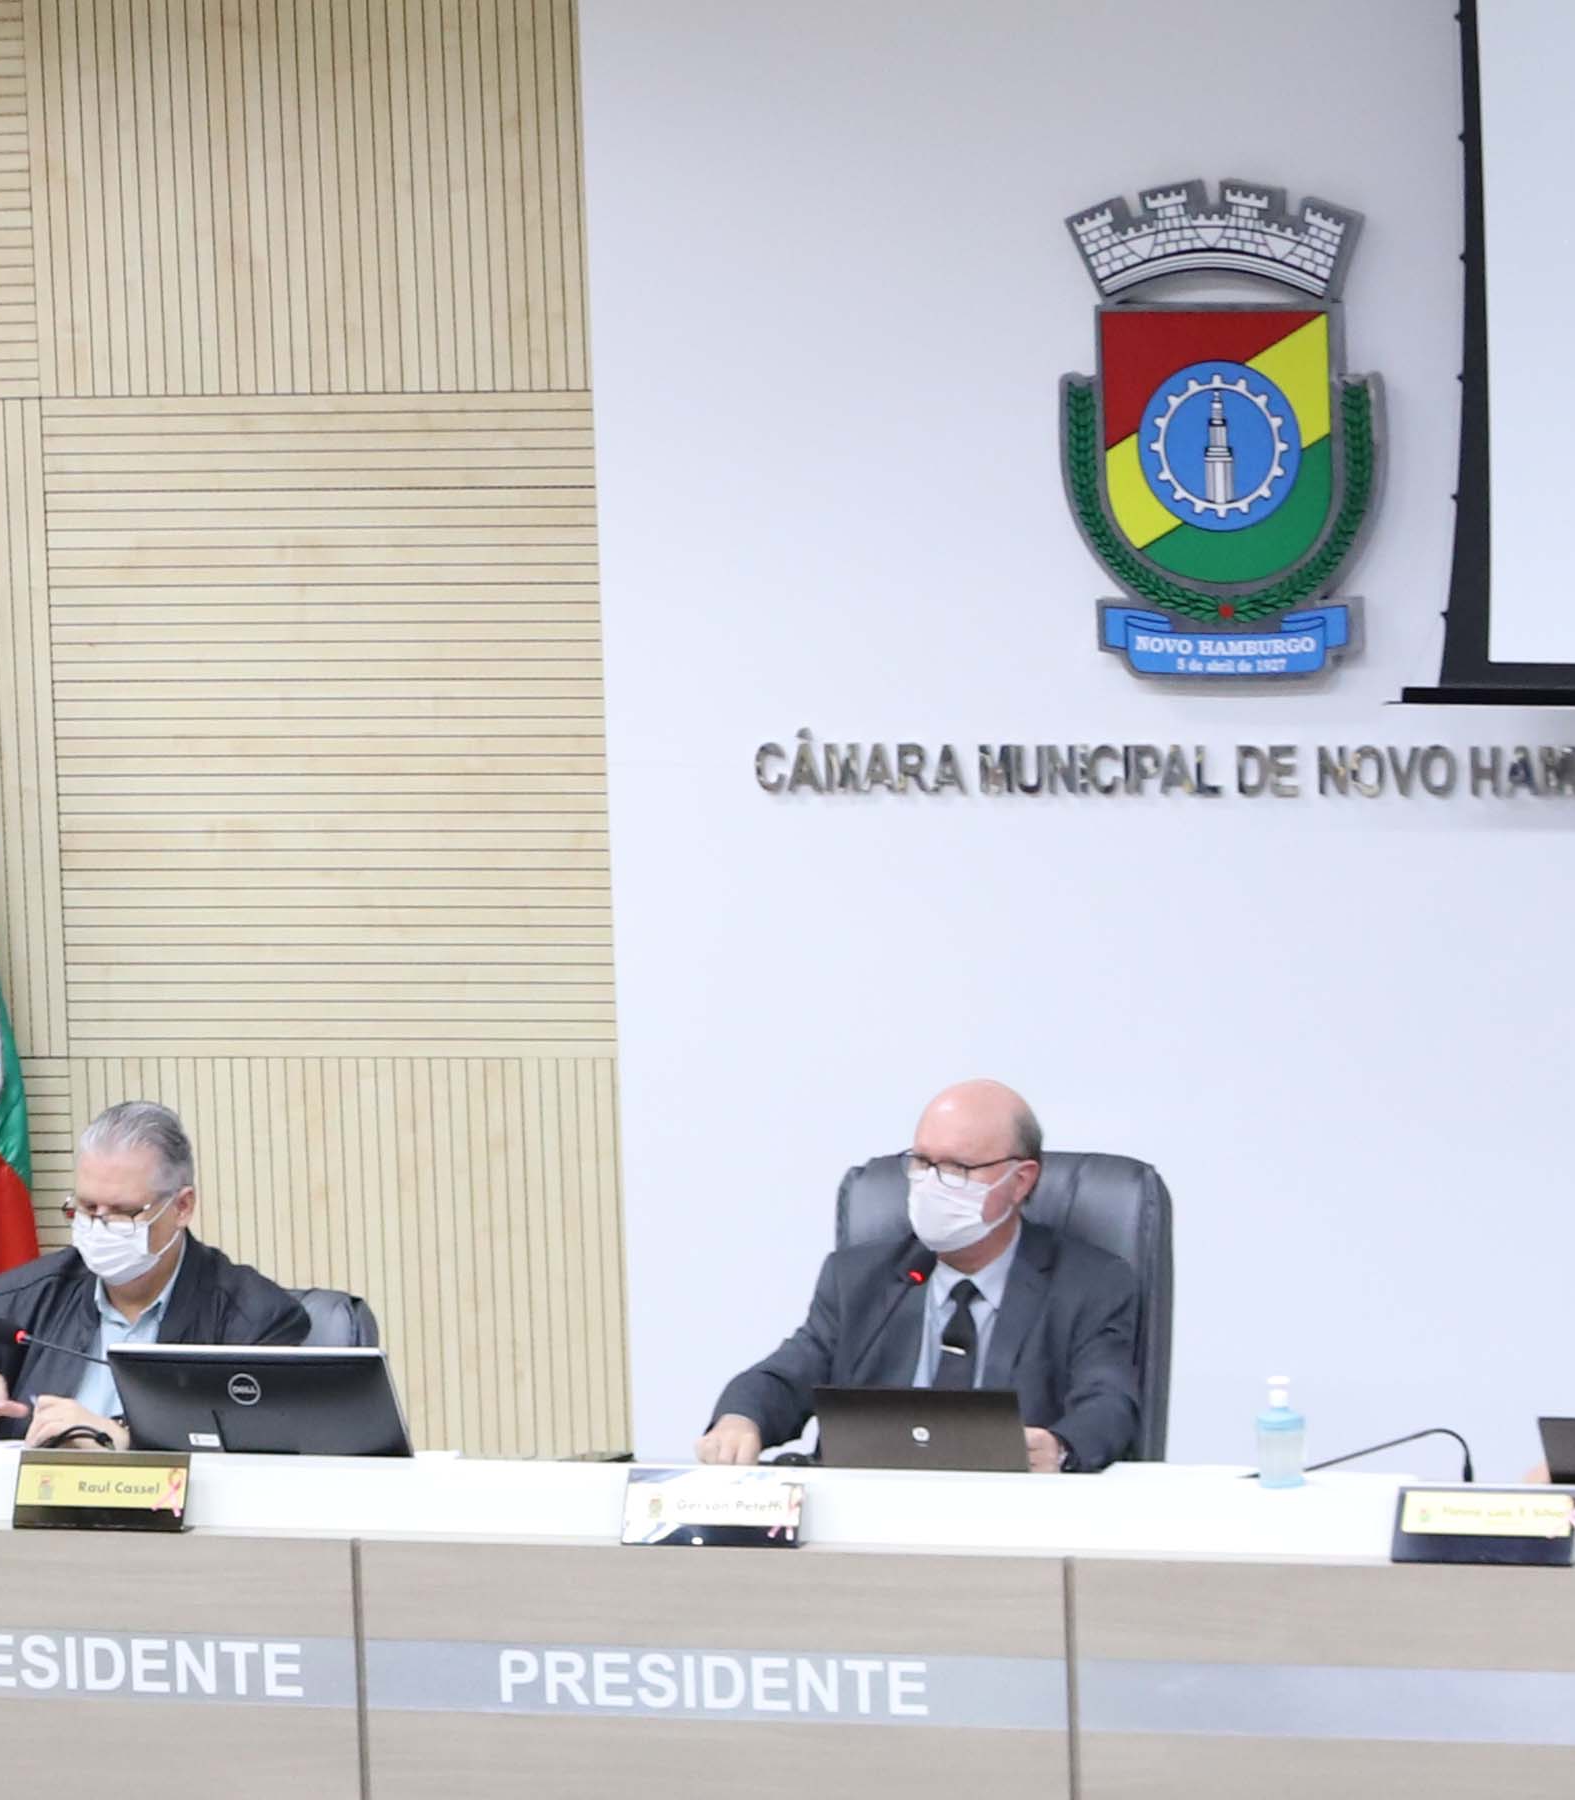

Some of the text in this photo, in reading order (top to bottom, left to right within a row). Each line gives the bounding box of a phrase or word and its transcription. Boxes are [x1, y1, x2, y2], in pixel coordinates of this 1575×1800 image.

[1135, 635, 1316, 656] NOVO HAMBURGO
[1188, 659, 1204, 671] de
[1237, 659, 1253, 671] de
[755, 727, 968, 796] CÂMARA
[978, 743, 1223, 798] MUNICIPAL
[1235, 744, 1300, 798] DE
[1317, 744, 1457, 798] NOVO
[78, 1481, 161, 1495] Raul Cassel
[499, 1649, 929, 1716] PRESIDENTE
